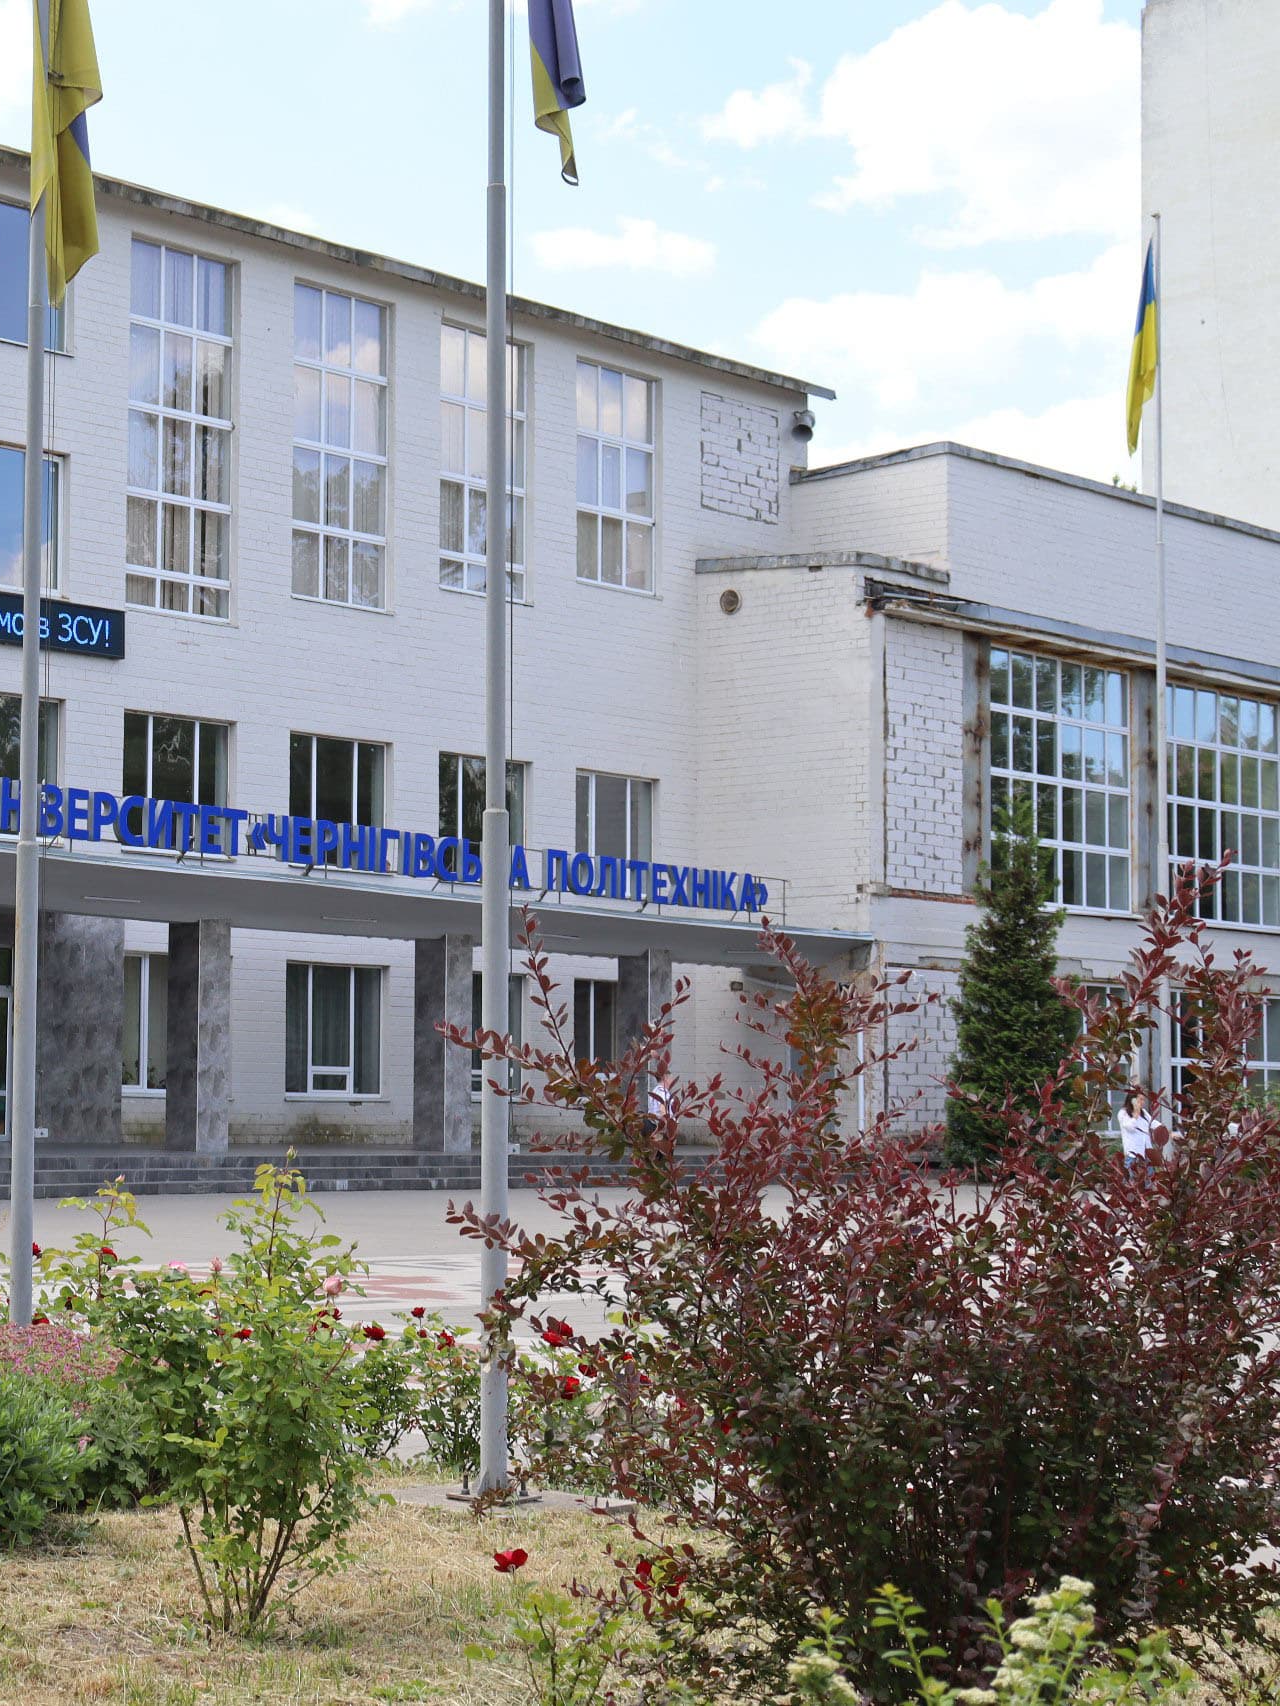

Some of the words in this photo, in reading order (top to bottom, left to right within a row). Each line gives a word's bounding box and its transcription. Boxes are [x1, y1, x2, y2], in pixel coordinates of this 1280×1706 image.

[57, 612, 110, 648] ЗСУ!
[250, 812, 530, 890] «ЧЕРНІГІВСЬА
[548, 848, 769, 913] ПОЛІТЕХНІКА»
